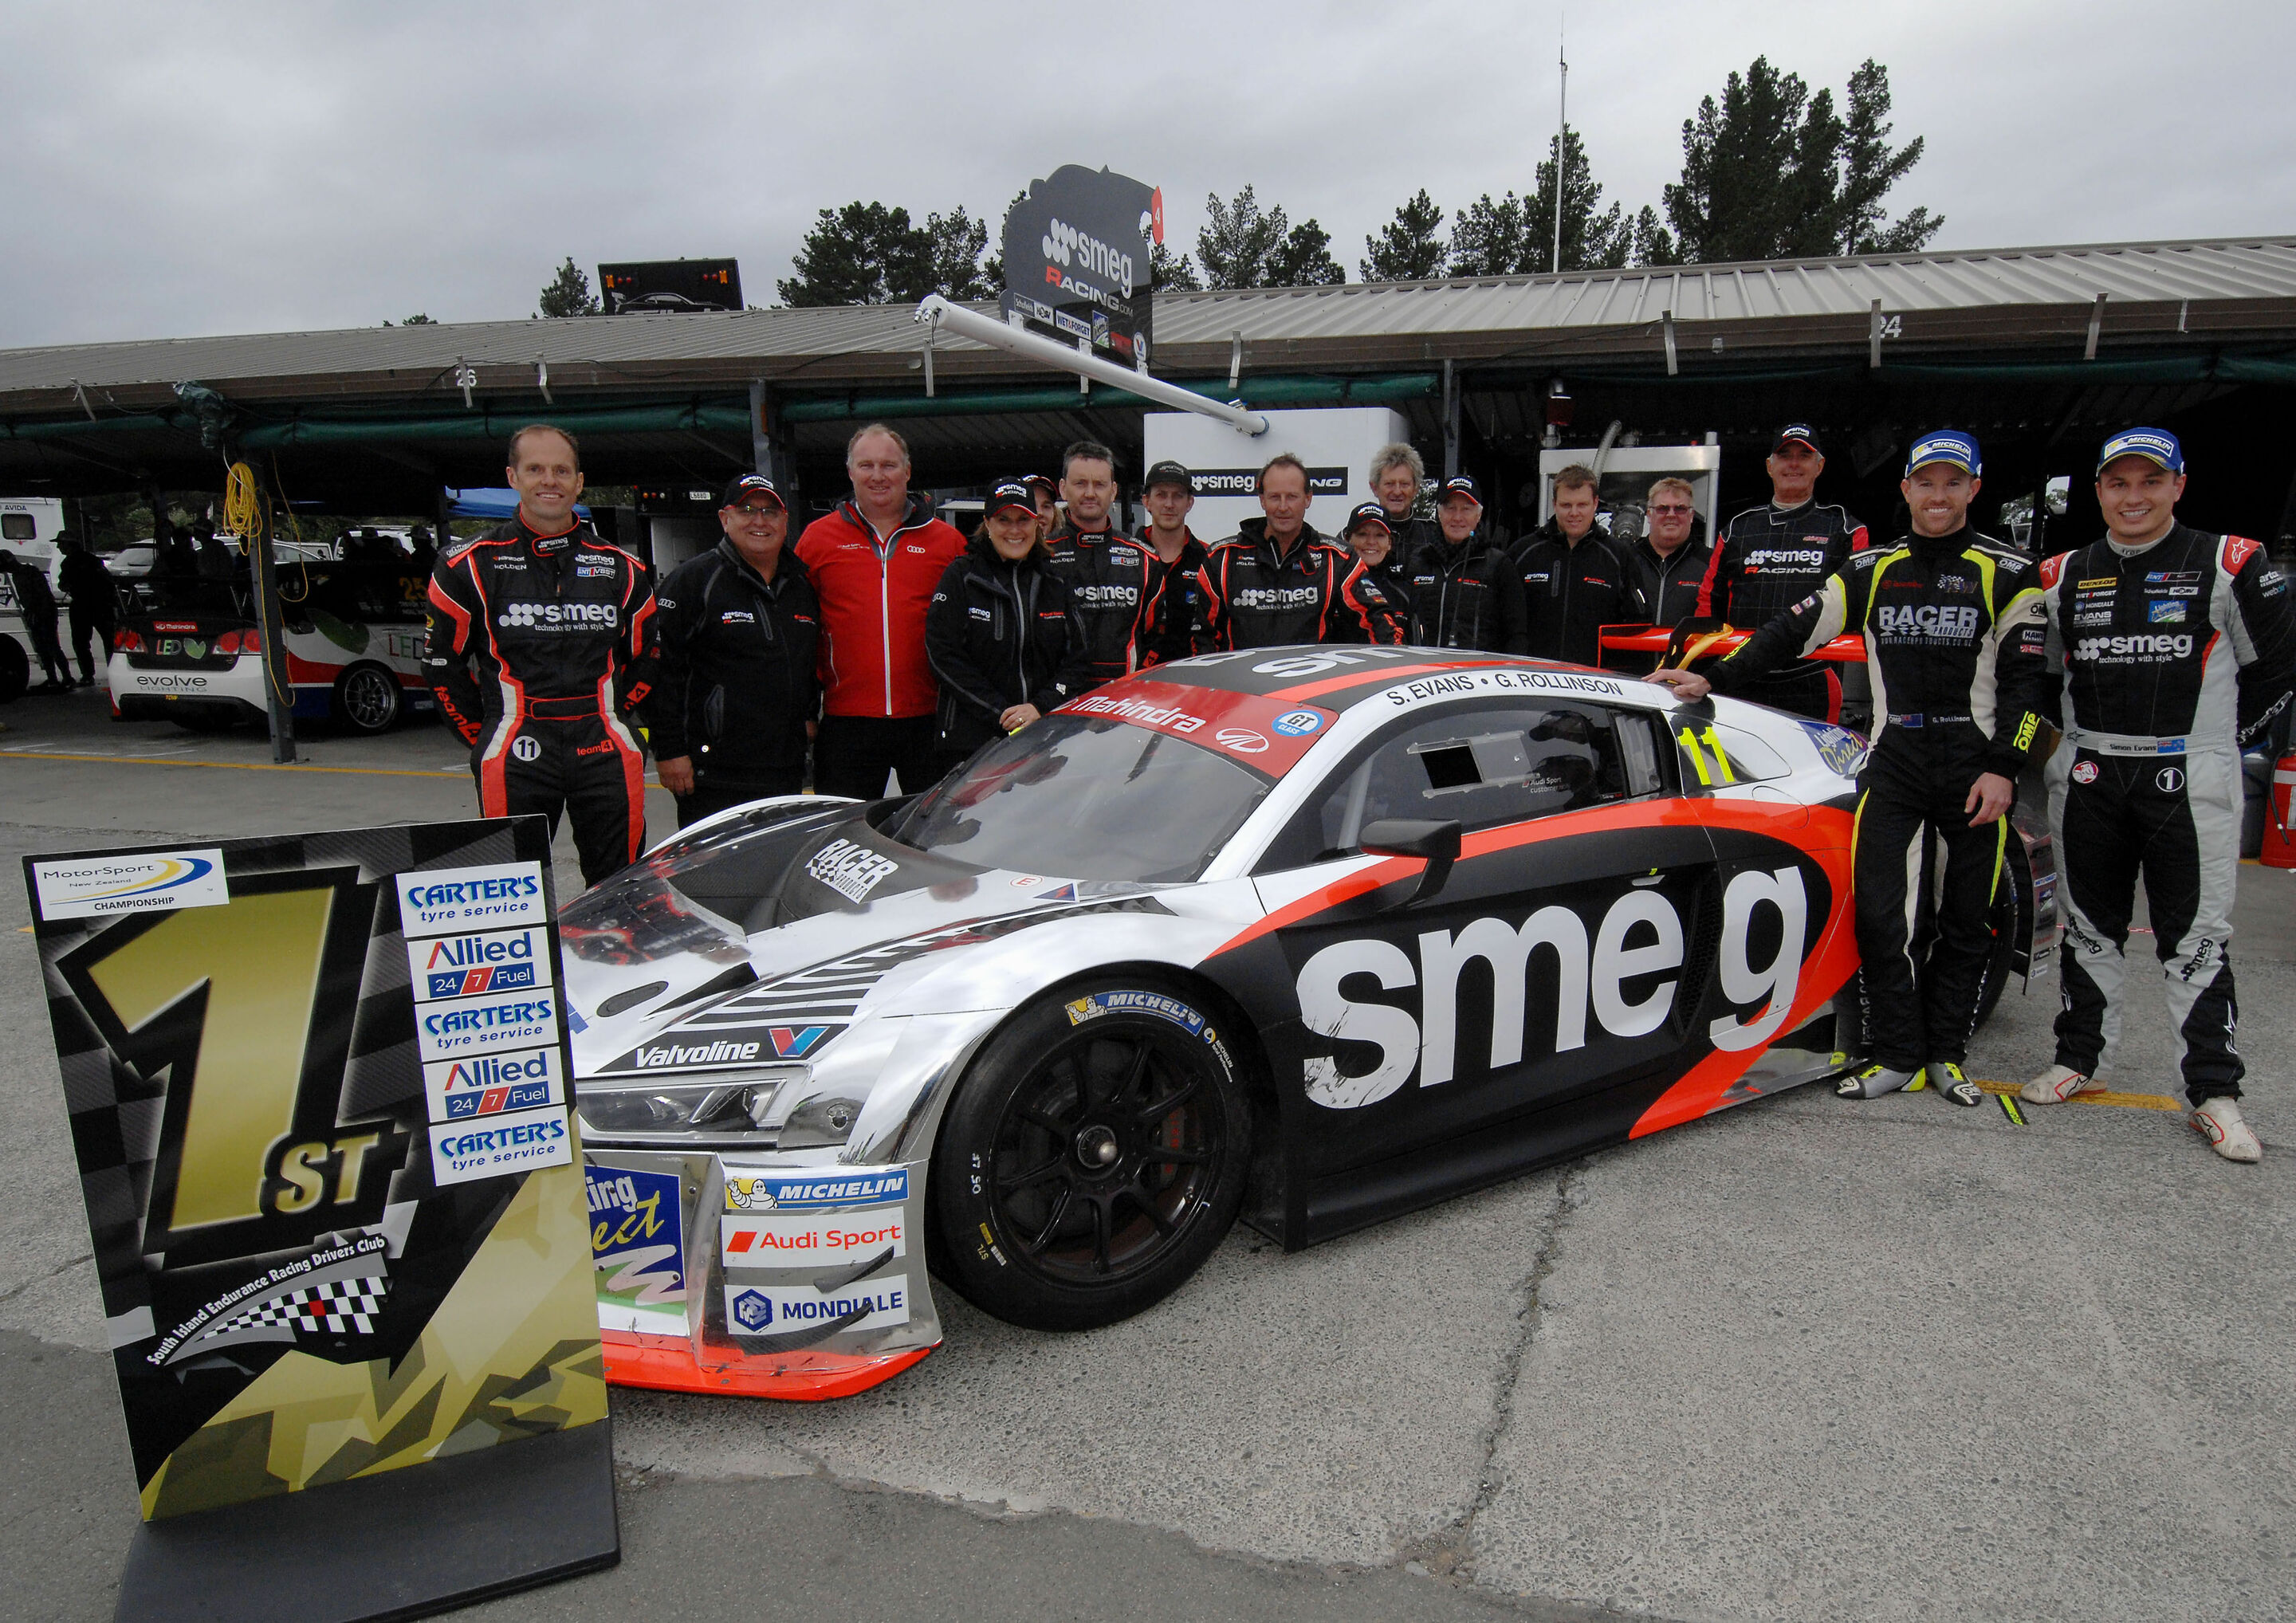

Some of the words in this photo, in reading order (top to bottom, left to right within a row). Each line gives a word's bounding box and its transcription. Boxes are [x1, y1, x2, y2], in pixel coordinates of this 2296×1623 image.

[1078, 232, 1132, 299] smeg
[1932, 442, 1970, 455] MICHELIN
[2128, 436, 2172, 450] MICHELIN
[1006, 483, 1027, 494] smeg
[1209, 476, 1255, 493] smeg
[589, 554, 615, 565] smeg
[1771, 549, 1824, 566] smeg
[1854, 556, 1877, 568] OMP
[1999, 558, 2024, 572] OMP
[399, 576, 428, 600] 25
[2079, 579, 2116, 588] DUNLOP
[1085, 586, 1138, 606] smeg
[1265, 587, 1318, 604] smeg
[545, 603, 618, 628] smeg
[971, 607, 991, 618] smeg
[1879, 605, 1979, 627] RACER
[2074, 611, 2112, 620] EVANS
[590, 623, 604, 631] style
[1932, 627, 1974, 637] PRODUCTS
[156, 639, 183, 655] LED
[388, 633, 425, 659] LED
[2111, 635, 2193, 658] smeg
[2099, 654, 2136, 663] technology
[2156, 654, 2173, 662] style
[137, 675, 207, 686] evolve
[1386, 691, 1410, 705] S.
[1409, 676, 1475, 699] EVANS
[1494, 674, 1517, 688] G.
[1517, 673, 1624, 696] ROLLINSON
[1071, 696, 1206, 733] Mahindra
[1287, 713, 1315, 727] GT
[1278, 724, 1301, 734] CLASS
[2018, 713, 2037, 751] OMP
[518, 739, 535, 758] 11
[1677, 726, 1735, 785] 11
[1546, 776, 1562, 786] Sport
[2163, 769, 2174, 790] 1
[44, 864, 155, 878] MotorSport
[804, 839, 898, 887] RACER
[94, 897, 175, 910] CHAMPIONSHIP
[407, 875, 539, 909] CARTER'S
[421, 909, 456, 922] tyre
[465, 902, 529, 916] service
[427, 932, 533, 969] Allied
[435, 978, 457, 992] 24
[472, 975, 483, 987] 7
[497, 968, 530, 984] Fuel
[1295, 866, 1807, 1109] smeg
[423, 1000, 552, 1036] CARTER'S
[1107, 993, 1201, 1027] MICHELIN
[438, 1035, 472, 1049] tyre
[480, 1026, 543, 1042] service
[635, 1040, 760, 1067] Valvoline
[1215, 1039, 1234, 1068] MICHELIN
[444, 1051, 548, 1091] Allied
[453, 1098, 474, 1112] 24
[489, 1094, 499, 1106] 7
[513, 1087, 545, 1103] Fuel
[439, 1119, 564, 1158] CARTER'S
[452, 1157, 486, 1170] tyre
[493, 1146, 556, 1162] service
[586, 1175, 637, 1213] ting
[778, 1177, 905, 1200] MICHELIN
[592, 1189, 664, 1252] ect
[759, 1232, 818, 1250] Audi
[826, 1224, 902, 1251] Sport
[147, 1335, 180, 1366] South
[172, 1309, 210, 1338] Island
[204, 1276, 269, 1315] Endurance
[269, 1256, 313, 1282] Racing
[311, 1244, 356, 1266] Drivers
[356, 1236, 386, 1252] Club
[782, 1291, 903, 1320] MONDIALE
